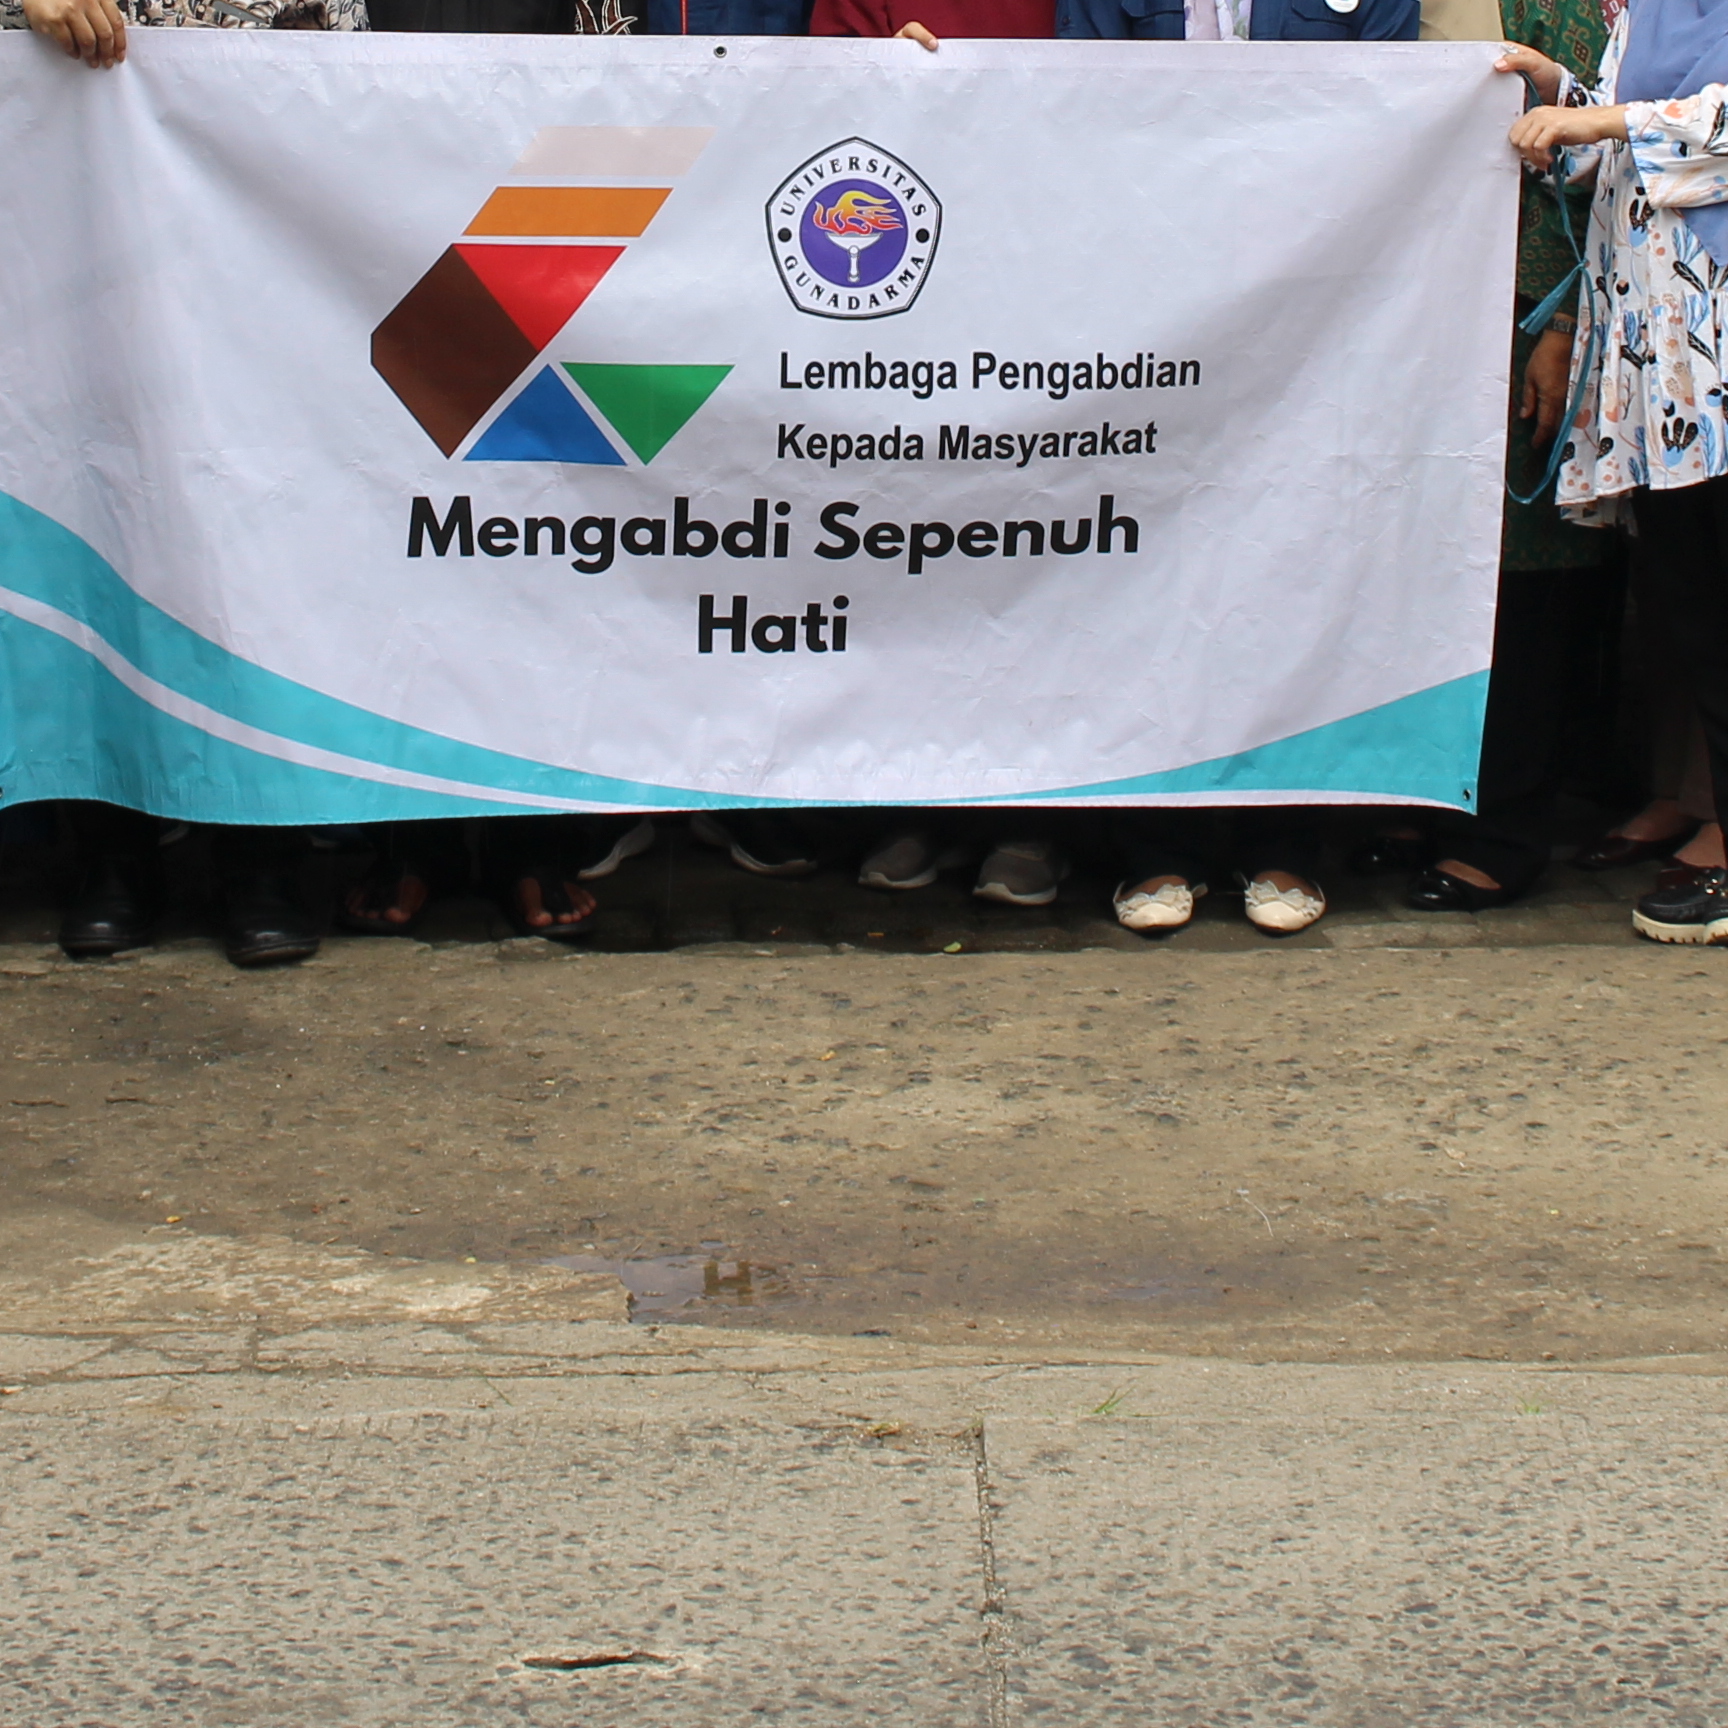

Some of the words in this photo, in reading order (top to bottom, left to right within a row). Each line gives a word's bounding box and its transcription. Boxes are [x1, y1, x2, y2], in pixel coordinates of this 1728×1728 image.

[779, 155, 927, 217] UNIVERSITAS
[783, 254, 926, 310] GUNADARMA
[779, 350, 958, 401] Lembaga
[972, 351, 1201, 401] Pengabdian
[777, 422, 925, 469] Kepada
[937, 420, 1159, 469] Masyarakat
[406, 495, 792, 575] Mengabdi
[813, 493, 1140, 576] Sepenuh
[697, 593, 850, 655] Hati
